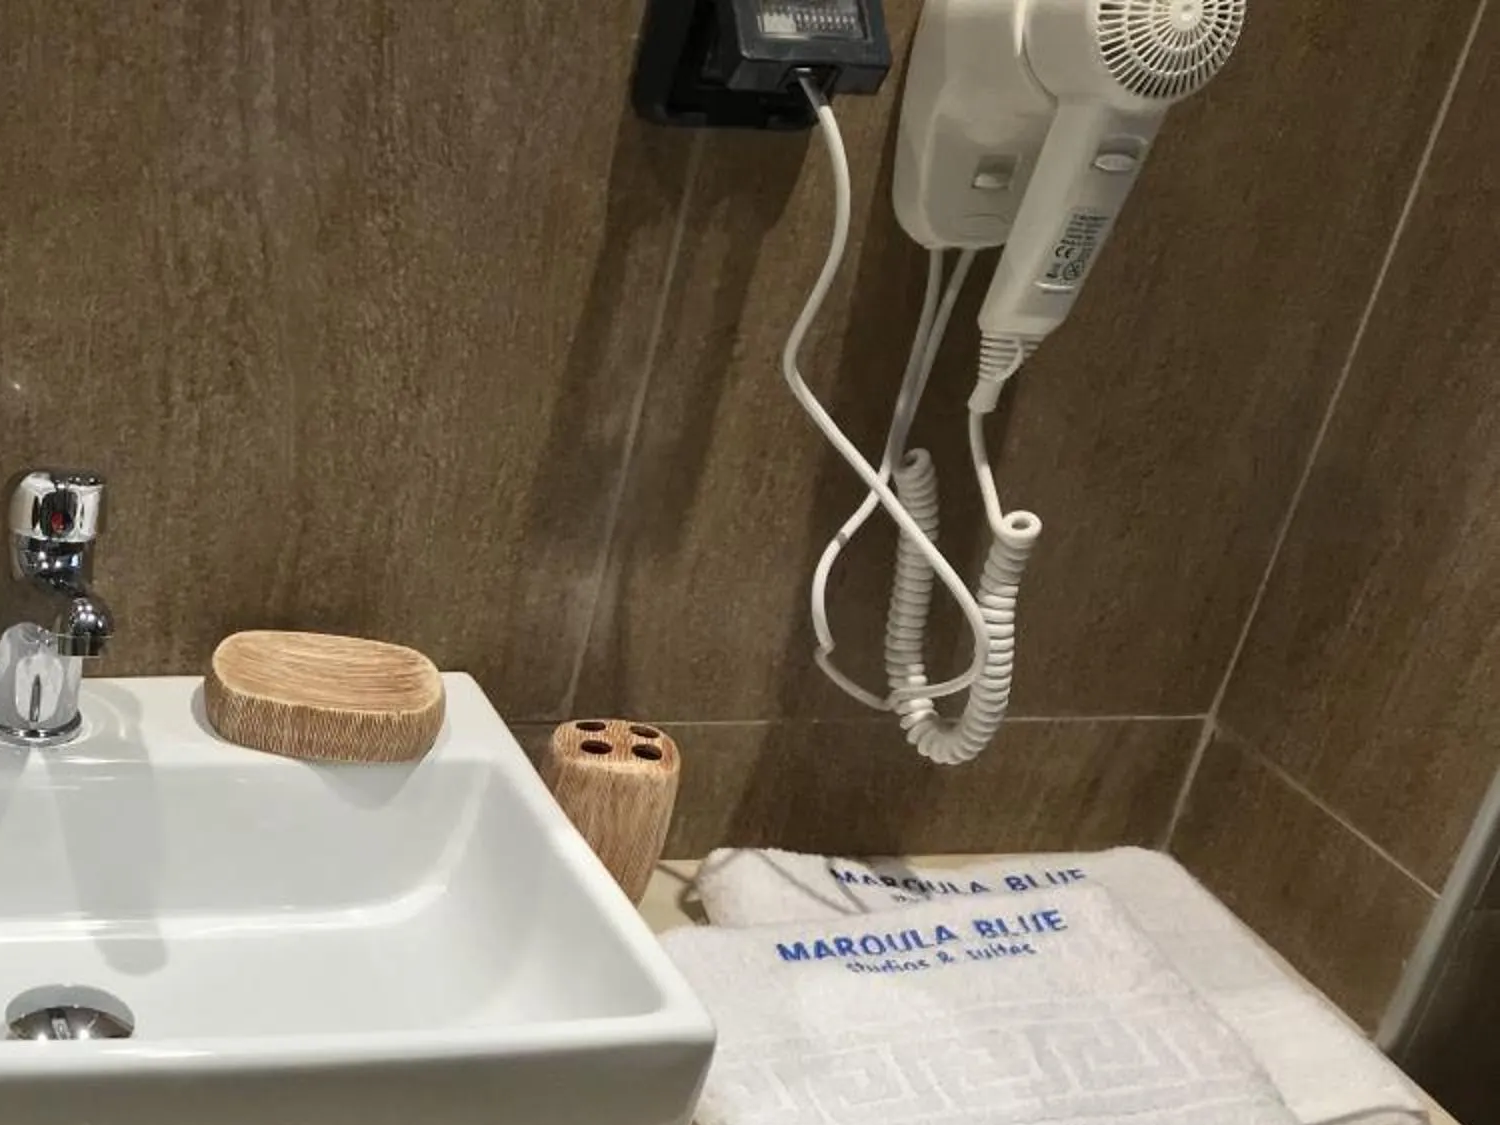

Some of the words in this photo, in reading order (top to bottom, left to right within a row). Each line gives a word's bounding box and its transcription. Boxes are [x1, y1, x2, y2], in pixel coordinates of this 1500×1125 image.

[1003, 866, 1088, 893] BLUE
[776, 924, 959, 963] MAROULA
[971, 909, 1070, 940] BLUE
[845, 956, 932, 974] studios
[936, 951, 956, 966] &
[966, 941, 1038, 961] suites
